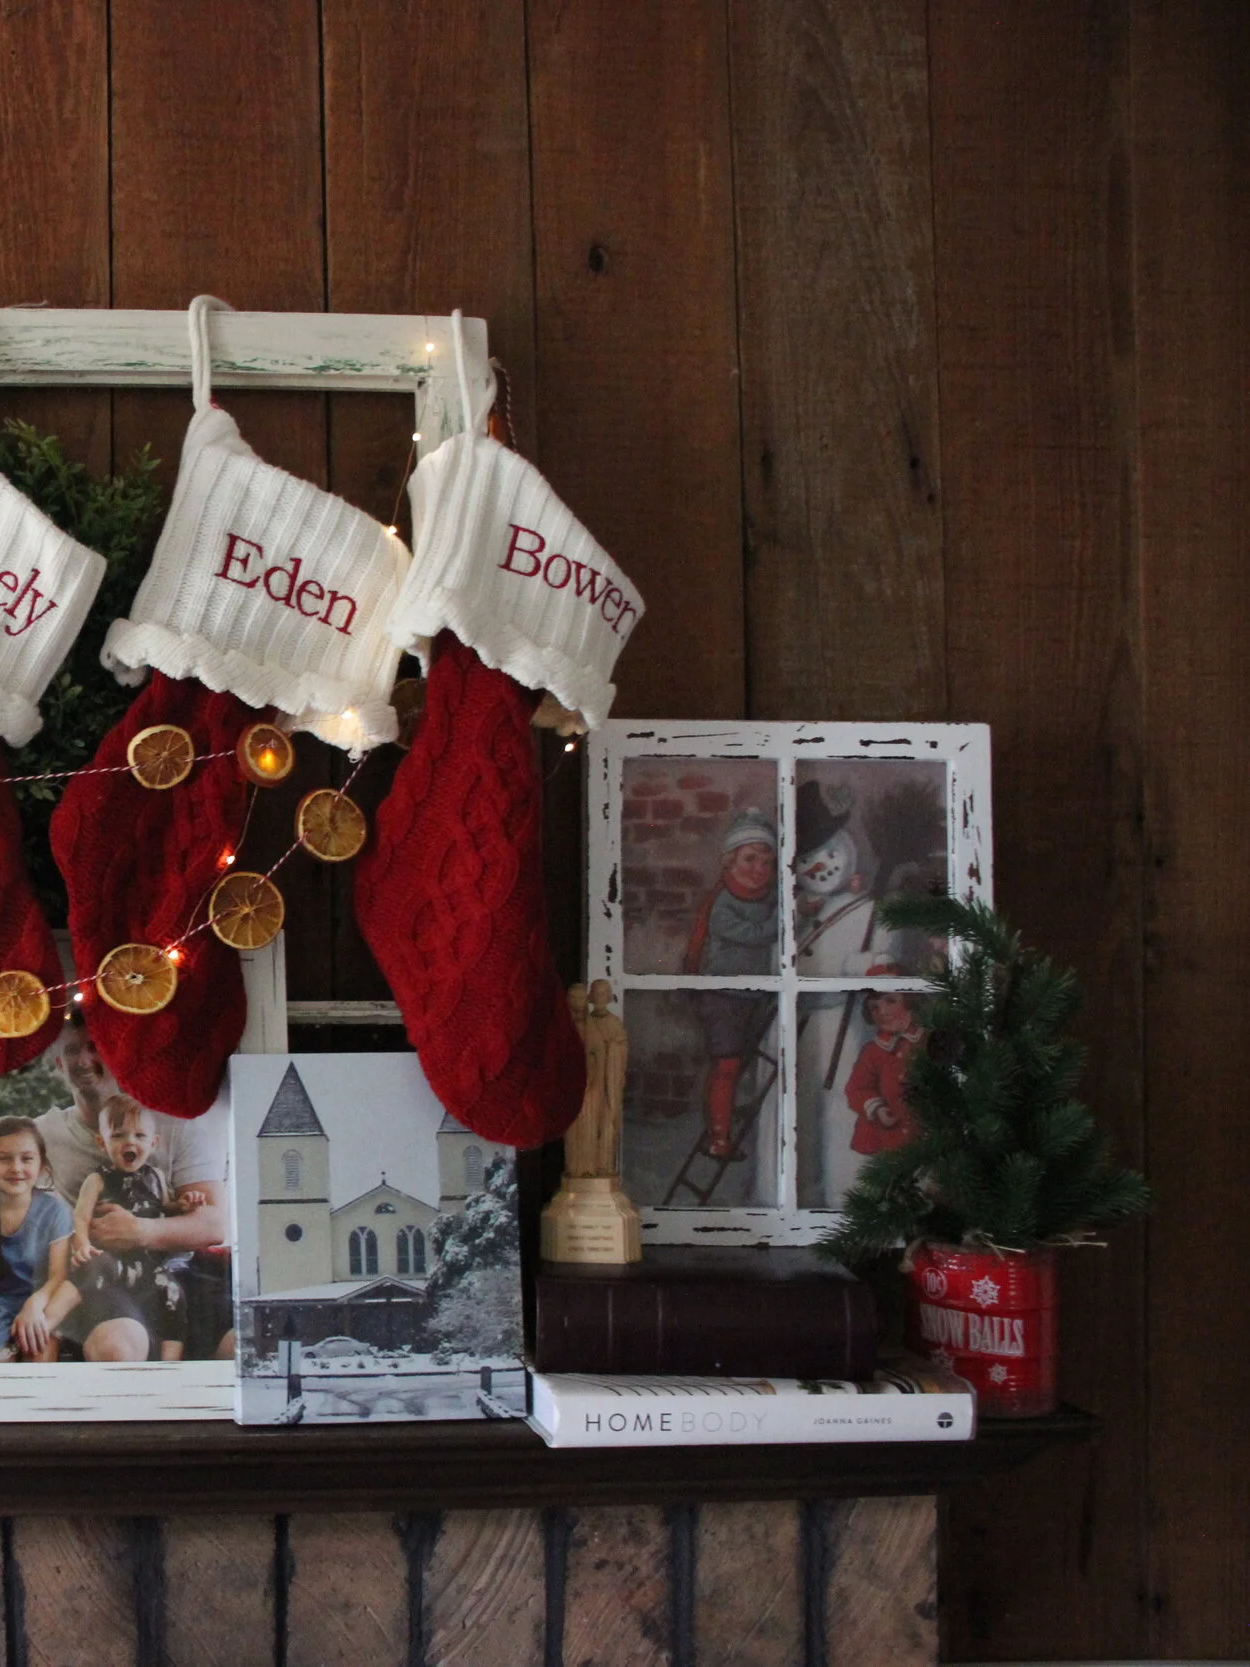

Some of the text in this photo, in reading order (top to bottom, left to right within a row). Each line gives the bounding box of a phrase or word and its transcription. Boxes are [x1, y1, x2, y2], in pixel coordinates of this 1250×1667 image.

[215, 533, 358, 636] Eden
[967, 1313, 1026, 1357] BALLS
[813, 1417, 853, 1425] JOANNA
[856, 1417, 892, 1425] GAINES
